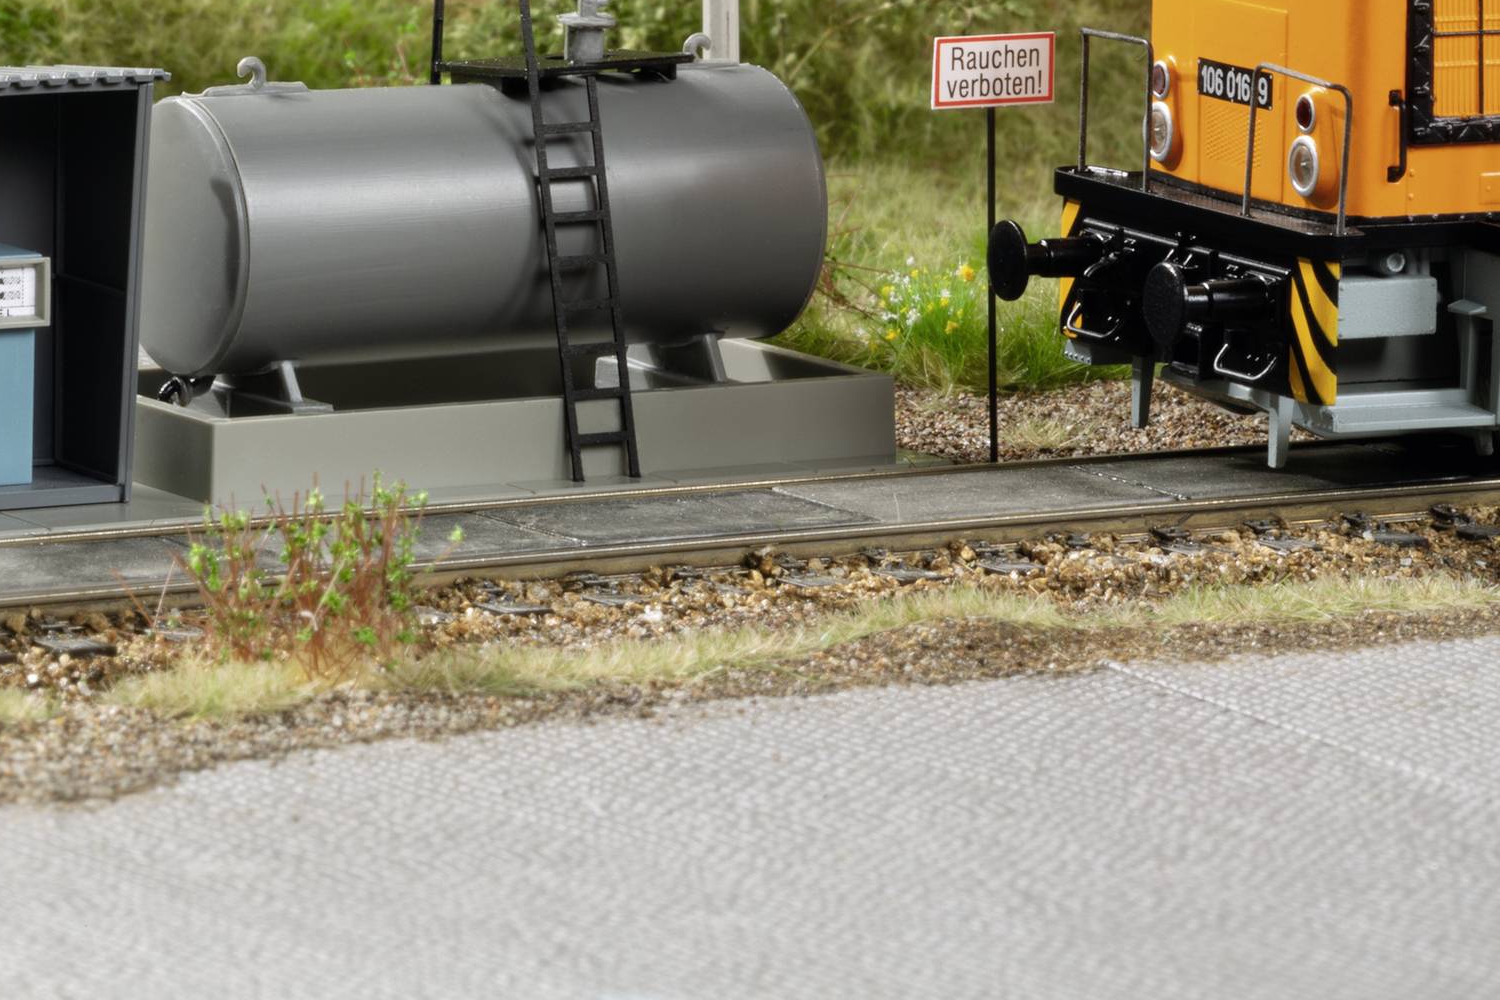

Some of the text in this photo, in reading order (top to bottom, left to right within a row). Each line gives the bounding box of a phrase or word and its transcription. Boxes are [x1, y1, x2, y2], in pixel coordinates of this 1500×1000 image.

[951, 44, 1040, 71] Rauchen
[947, 70, 1042, 98] verboten!
[1201, 65, 1268, 105] 106 016 9
